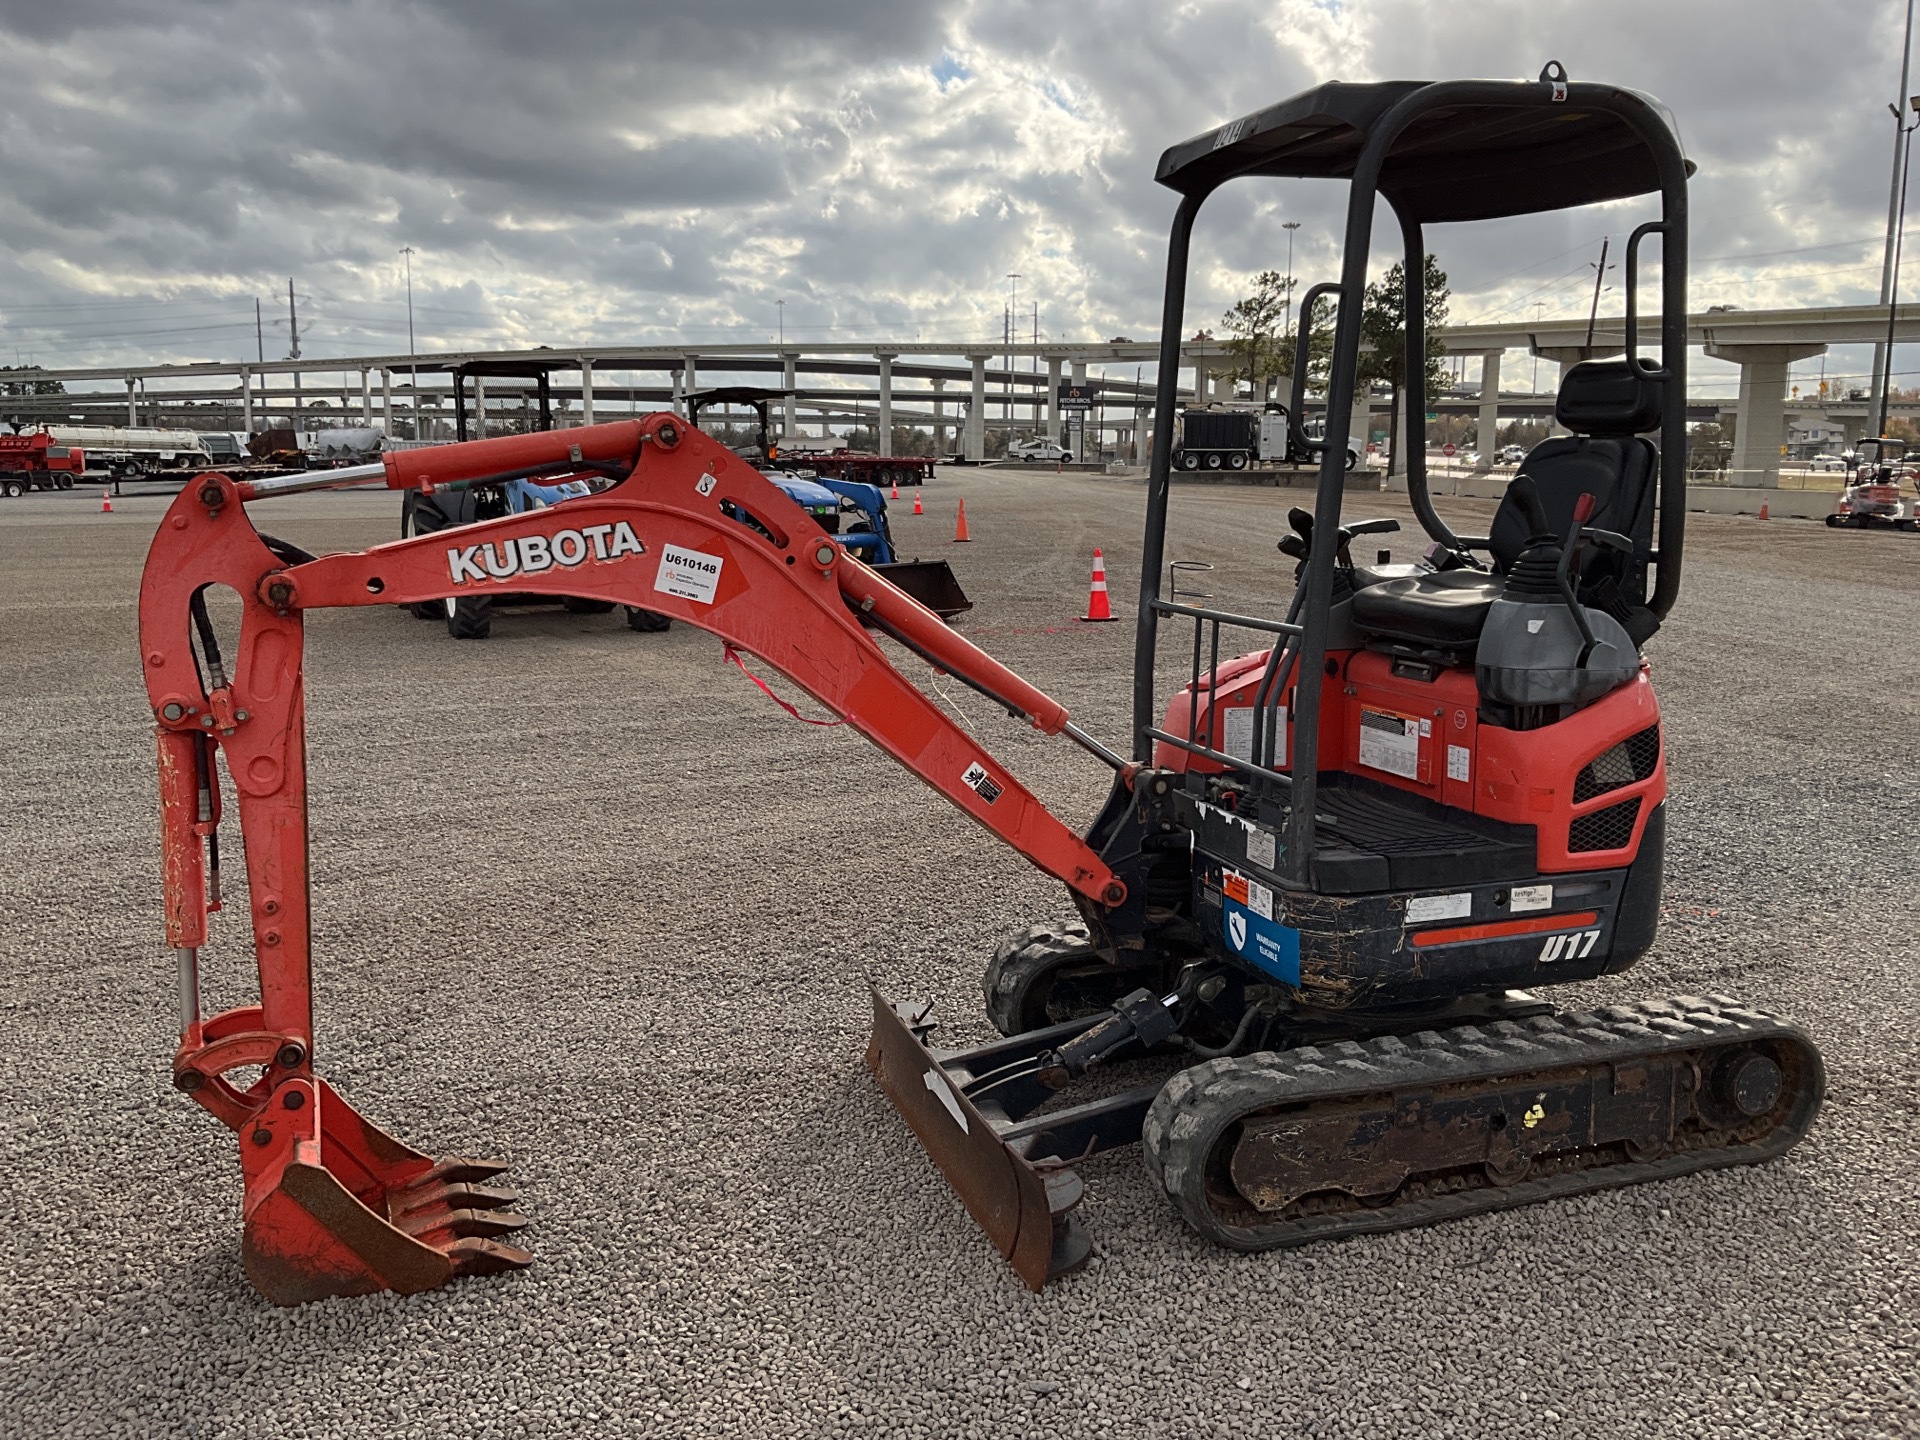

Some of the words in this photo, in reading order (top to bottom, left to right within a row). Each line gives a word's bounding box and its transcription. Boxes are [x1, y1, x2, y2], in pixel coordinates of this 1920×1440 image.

[1069, 387, 1080, 397] rb
[447, 520, 645, 584] KUBOTA
[665, 553, 717, 574] U610148
[665, 570, 675, 579] rb
[1256, 932, 1280, 952] WARRANTY
[1539, 930, 1600, 962] U17
[1260, 945, 1278, 962] ELIGIBLE
